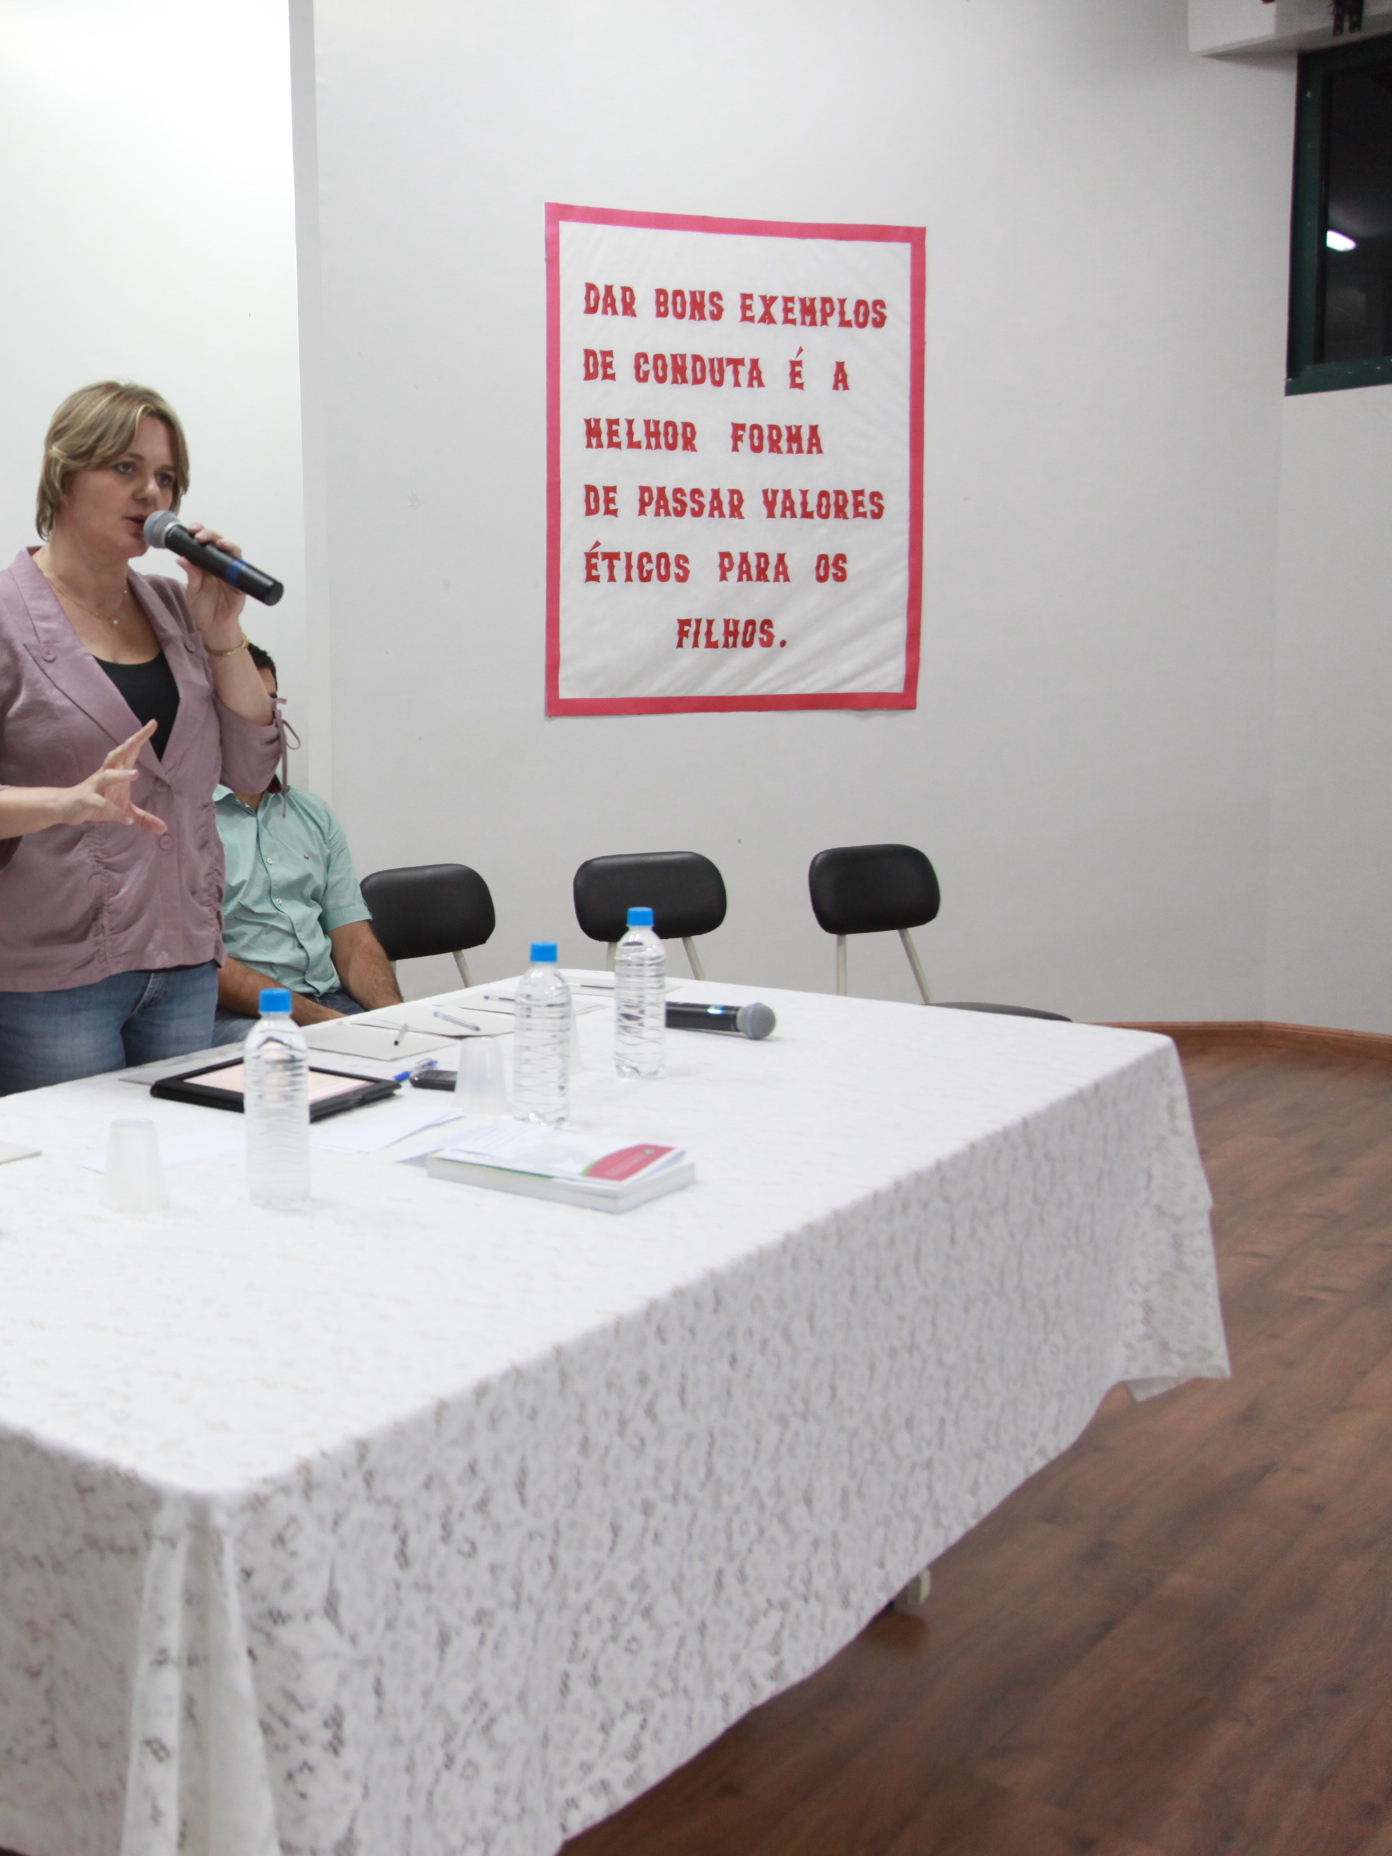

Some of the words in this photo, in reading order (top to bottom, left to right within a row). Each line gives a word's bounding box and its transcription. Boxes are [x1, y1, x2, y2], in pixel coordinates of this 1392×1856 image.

[583, 282, 637, 318] DAR
[654, 288, 725, 322] BONS
[739, 292, 887, 330] EXEMPLOS
[583, 348, 617, 382] DE
[633, 352, 765, 388] CONDUTA
[788, 347, 805, 391] É
[832, 361, 850, 391] A
[583, 418, 698, 453] MELHOR
[730, 422, 824, 455] FORMA
[583, 484, 619, 518] DE
[637, 485, 745, 520] PASSAR
[761, 488, 885, 520] VALORES
[583, 540, 691, 584] ÉTICOS
[717, 551, 791, 583] PARA
[814, 553, 848, 584] OS
[675, 618, 787, 650] FILHOS.
